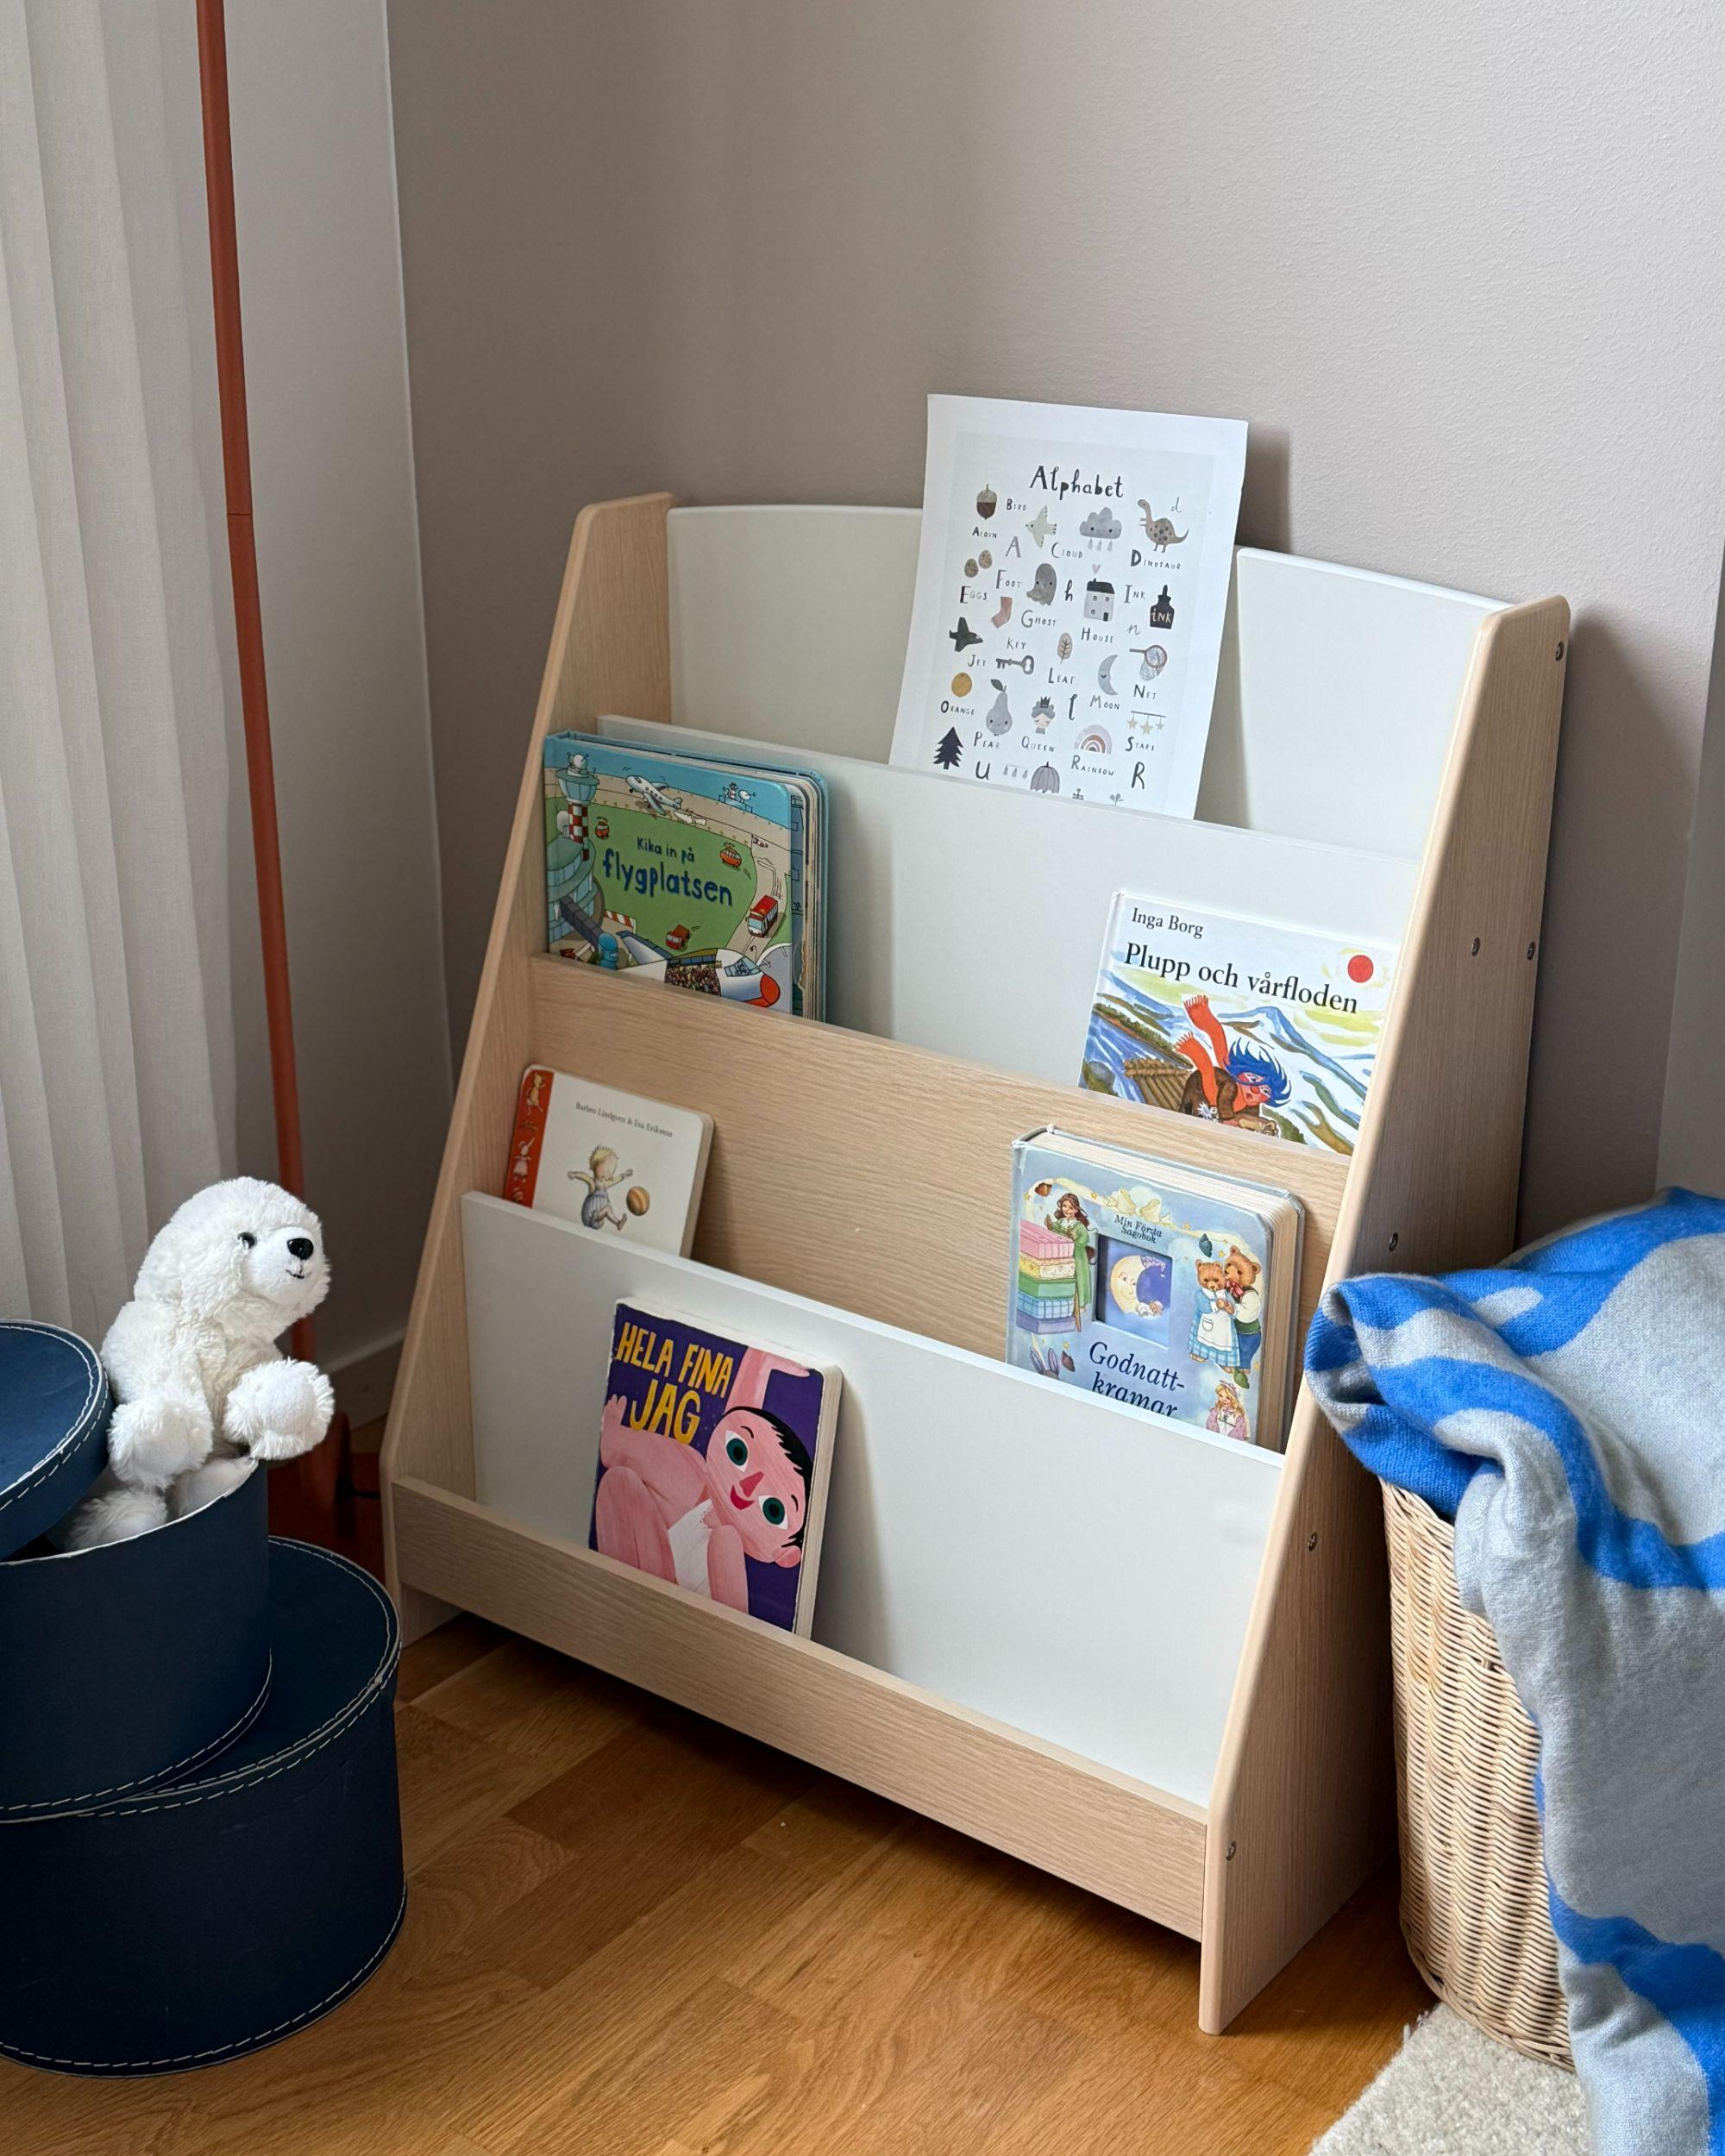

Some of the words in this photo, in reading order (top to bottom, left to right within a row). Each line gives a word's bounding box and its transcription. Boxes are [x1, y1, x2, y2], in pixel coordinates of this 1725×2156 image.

[1029, 465, 1124, 501] Alphabet
[1006, 498, 1028, 511] BIRD
[1005, 536, 1022, 559] A
[1051, 542, 1083, 559] CLOUD
[1130, 548, 1182, 570] DINOSAUR
[995, 569, 1022, 589] FOOT
[959, 585, 988, 605] EGGS
[1064, 579, 1073, 602] h
[1123, 584, 1146, 604] INK
[1020, 609, 1057, 629] GHOST
[1007, 636, 1027, 650] KEY
[1081, 627, 1114, 643] HOUSE
[1047, 667, 1076, 685] LEAF
[1132, 684, 1158, 700] NET
[940, 700, 975, 716] ORANGE
[1089, 694, 1120, 711] MOON
[973, 730, 1000, 749] PEAR
[1021, 736, 1055, 753] QUEEN
[1125, 736, 1155, 752] STARS
[1070, 754, 1115, 776] RAINBOW
[1131, 761, 1145, 790] R
[637, 836, 662, 855] Kika
[666, 845, 677, 859] in
[681, 847, 695, 864] på
[602, 848, 734, 907] flygplatsen
[1131, 906, 1164, 931] Inga
[1168, 914, 1204, 940] Borg
[1124, 942, 1191, 981] Plupp
[1197, 962, 1239, 988] och
[1247, 971, 1358, 1015] vårfloden
[627, 1117, 633, 1125] &
[1114, 1214, 1132, 1228] Min
[1135, 1220, 1163, 1238] Första
[1121, 1225, 1157, 1244] Sagobok
[614, 1321, 674, 1379] HELA
[678, 1343, 735, 1399] FINA
[1088, 1341, 1186, 1392] Godnatt-
[1091, 1370, 1179, 1418] kramar
[629, 1379, 702, 1445] JAG
